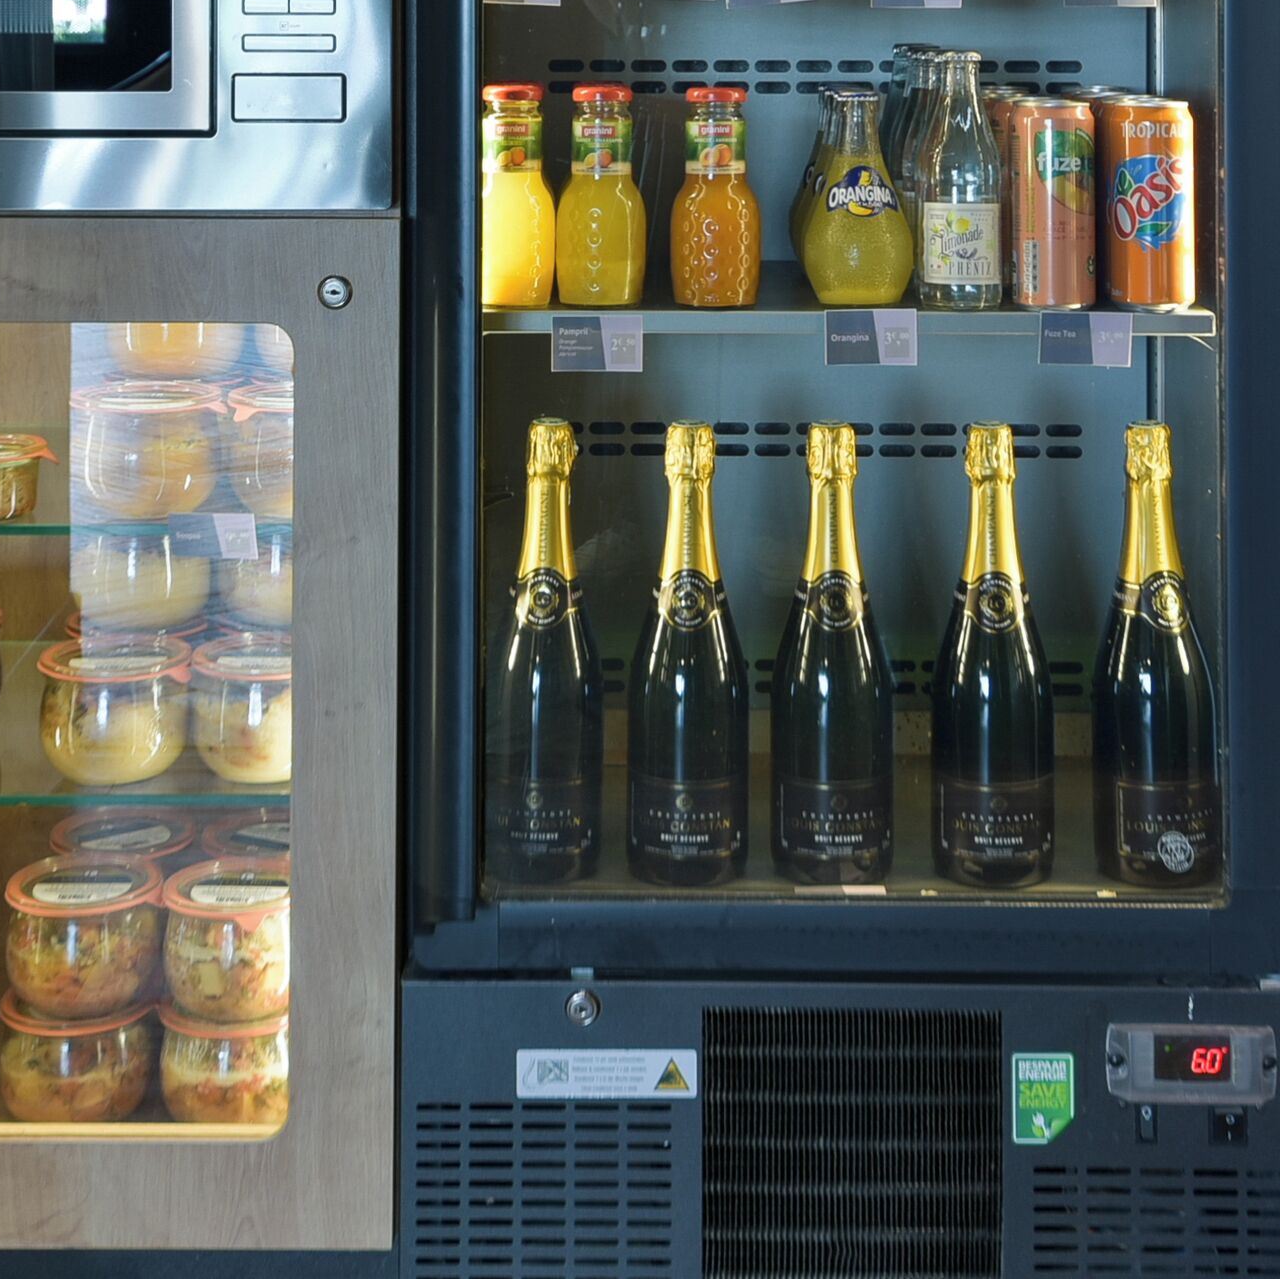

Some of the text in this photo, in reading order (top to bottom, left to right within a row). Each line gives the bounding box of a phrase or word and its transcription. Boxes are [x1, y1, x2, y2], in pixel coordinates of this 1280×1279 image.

[496, 125, 526, 136] granini
[583, 127, 613, 137] granini
[700, 126, 730, 136] granini
[1036, 151, 1082, 172] fuze
[828, 186, 893, 208] ORANGINA
[558, 327, 589, 337] Pampril
[1063, 329, 1077, 338] Tea
[830, 333, 870, 344] Orangina
[537, 490, 549, 563] CHAMPAGNE
[682, 493, 693, 565] CHAMPAGNE
[828, 491, 840, 564] CHAMPAGNE
[987, 494, 998, 565] CHAMPAGNE
[1018, 1060, 1067, 1071] BESPAAR
[1018, 1070, 1067, 1081] ENERGIE
[1019, 1082, 1067, 1098] SAVE
[1019, 1097, 1066, 1109] ENERGY
